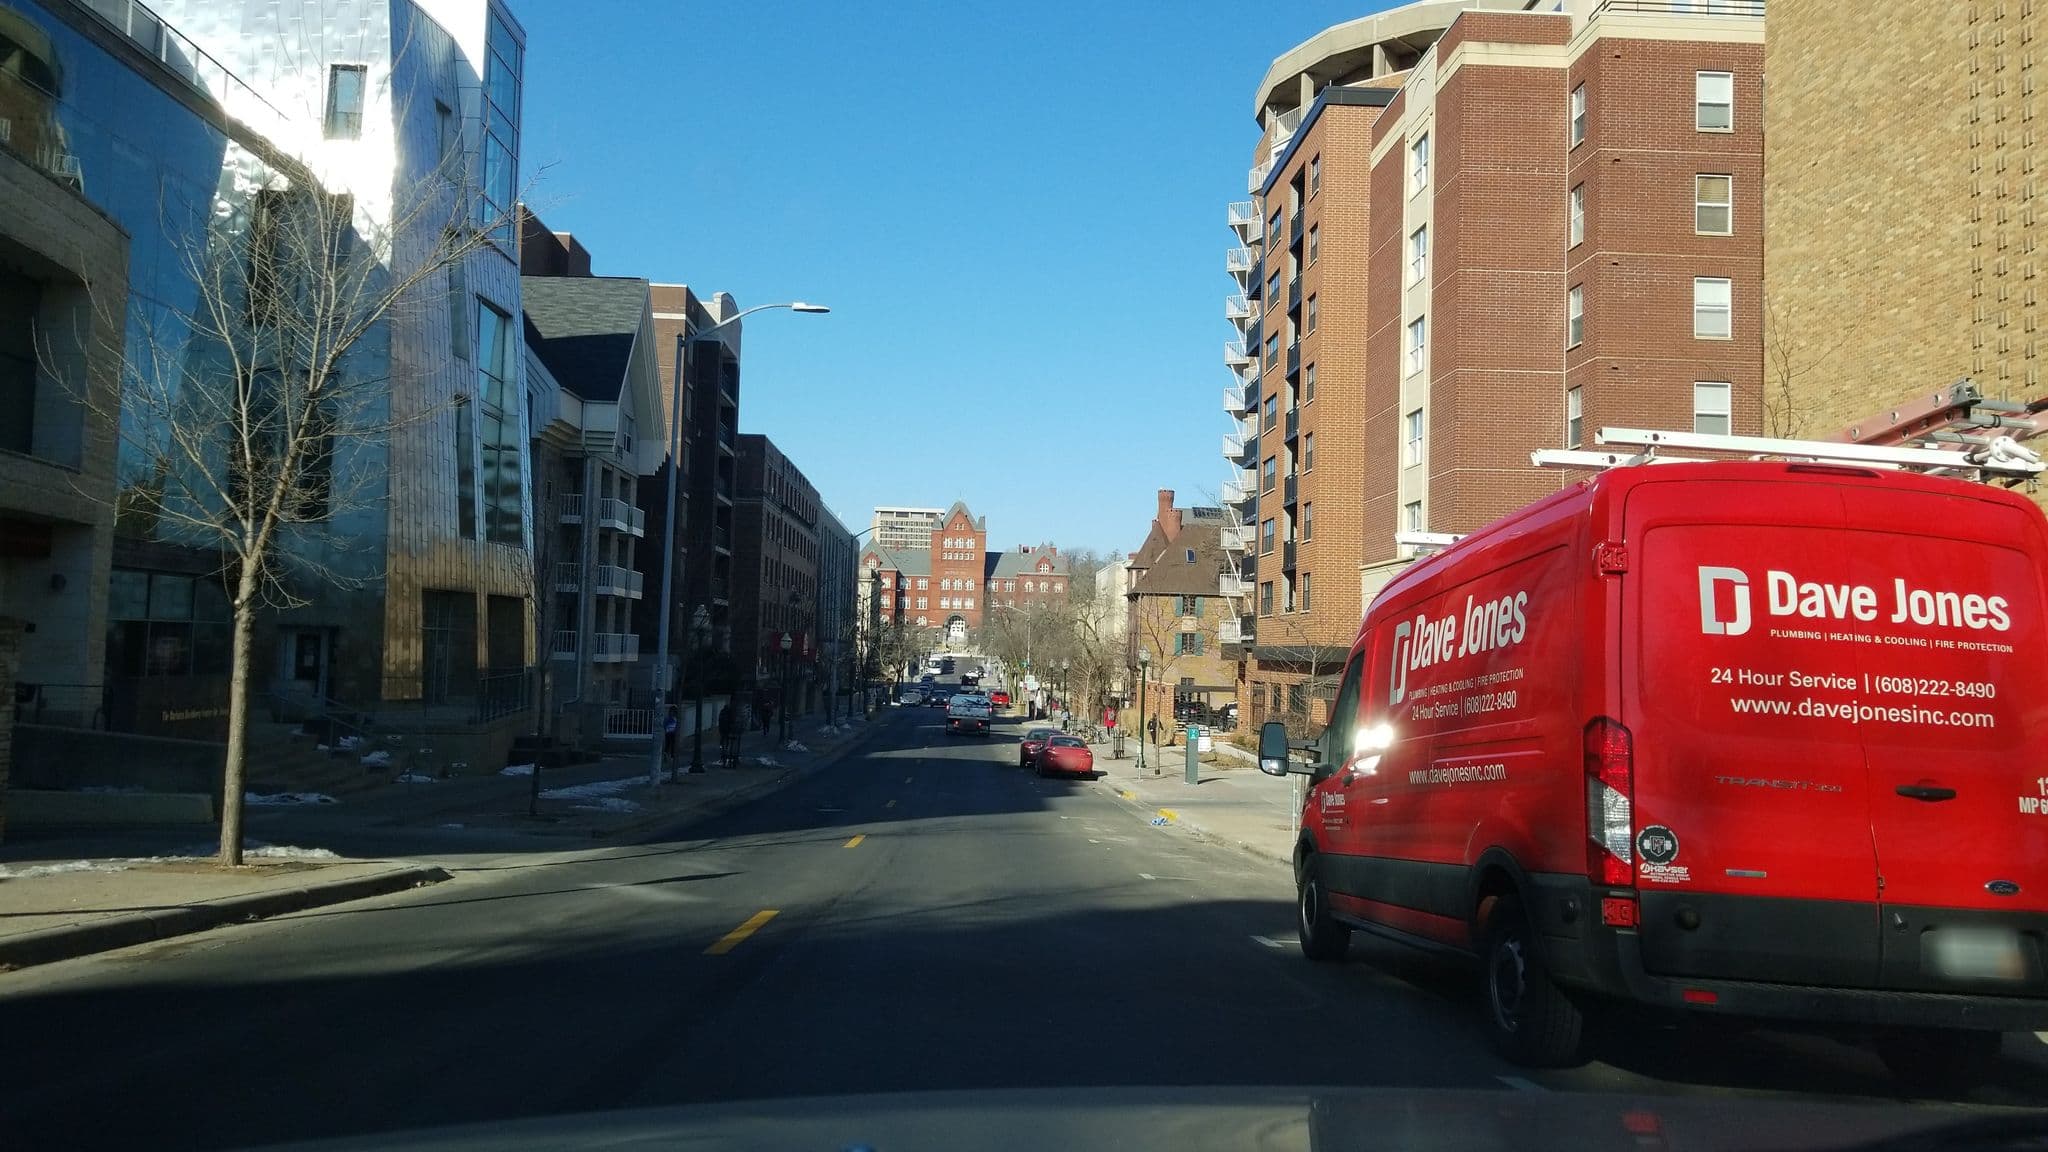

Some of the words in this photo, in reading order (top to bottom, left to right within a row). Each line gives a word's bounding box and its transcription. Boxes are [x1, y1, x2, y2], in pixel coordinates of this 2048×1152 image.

[1767, 570, 1878, 622] Dave
[1891, 578, 2011, 632] Jones
[1410, 613, 1456, 671] Dave
[1458, 590, 1528, 659] Jones
[1770, 629, 1822, 641] PLUMBING
[1830, 632, 1872, 644] HEATING
[1874, 635, 1882, 644] &
[1884, 635, 1927, 648] COOLING
[1935, 639, 1955, 650] FIRE
[1957, 641, 2014, 653] PROTECTION
[1430, 684, 1448, 696] HEATING
[1452, 678, 1474, 691] COOLING
[1477, 675, 1488, 687] FIRE
[1489, 667, 1524, 685] PROTECTION
[1710, 667, 1733, 685] 24
[1738, 669, 1784, 687] Hour
[1789, 671, 1857, 691] Service
[1875, 675, 1996, 700] (608)222-8490
[1411, 705, 1419, 721] 24
[1420, 702, 1434, 720] Hour
[1435, 699, 1459, 718] Service
[1464, 690, 1517, 717] (608)222-8490
[1730, 697, 1995, 728] www.davejonesinc.com
[1408, 761, 1507, 787] www.davejonesinc.com
[2018, 796, 2039, 814] MP
